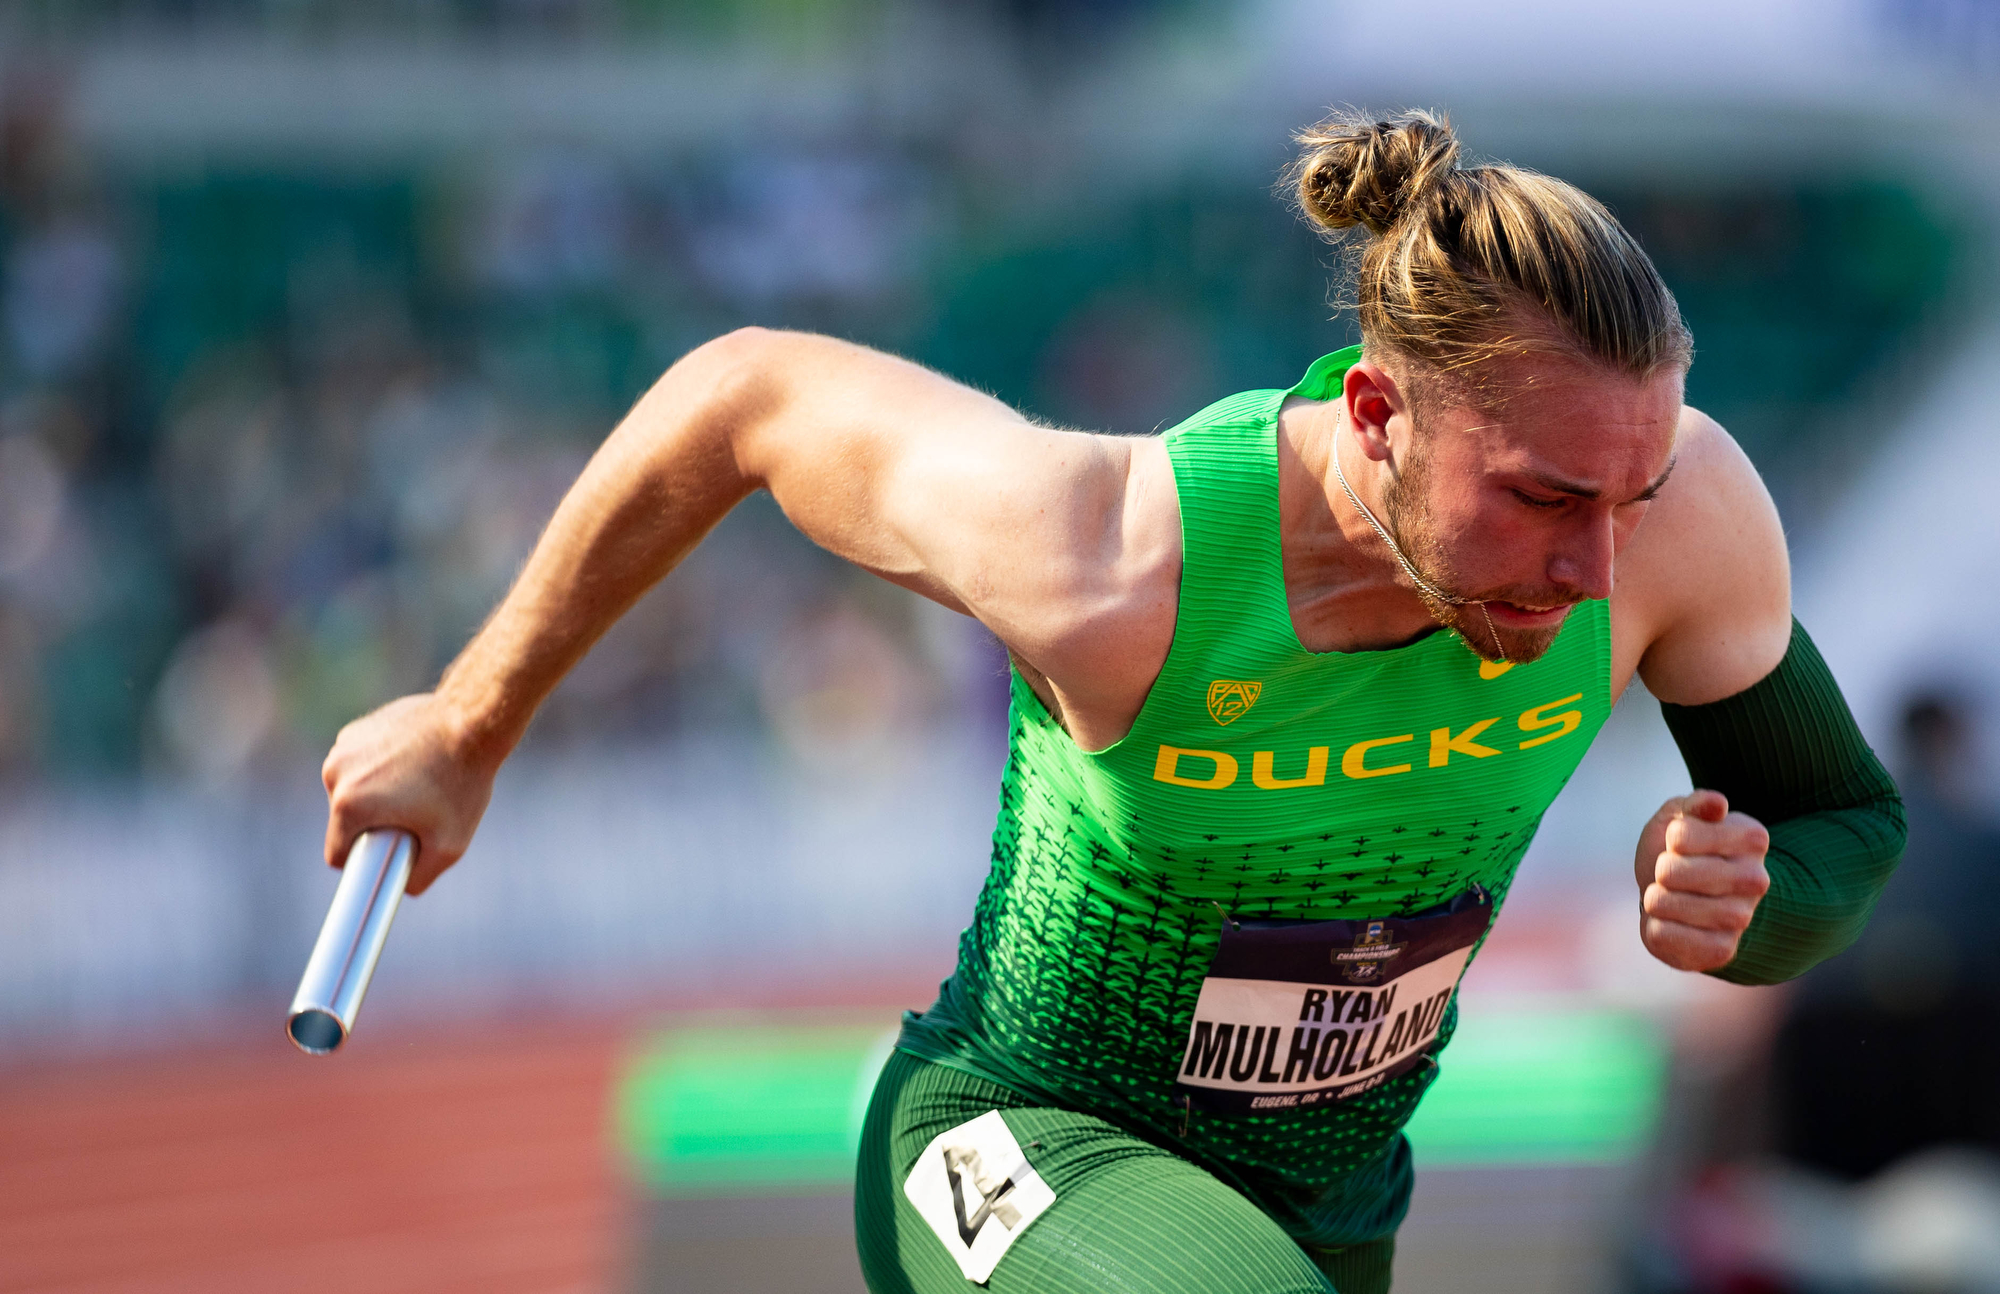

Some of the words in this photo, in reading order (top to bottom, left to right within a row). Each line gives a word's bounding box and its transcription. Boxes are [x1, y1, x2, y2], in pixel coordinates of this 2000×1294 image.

[1210, 683, 1259, 708] PAC
[1216, 701, 1243, 716] 12
[1153, 692, 1583, 790] DUCKS
[1336, 947, 1401, 960] CHAMPIONSHIPS
[1299, 983, 1398, 1024] RYAN
[1183, 986, 1452, 1084] MULHOLLAND
[1250, 1094, 1299, 1109] EUGENE,
[1337, 1080, 1367, 1099] JUNE
